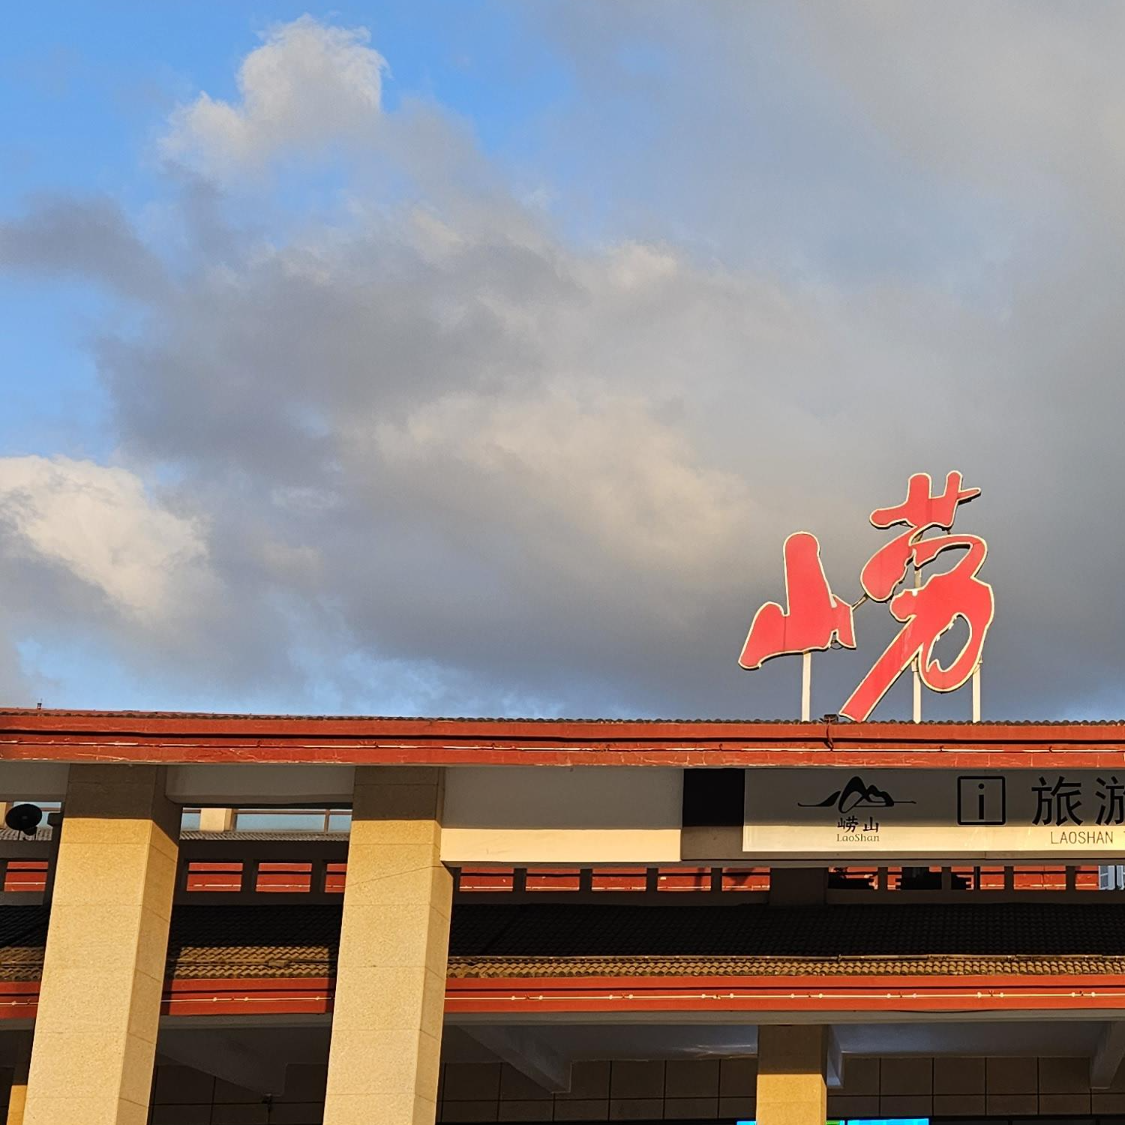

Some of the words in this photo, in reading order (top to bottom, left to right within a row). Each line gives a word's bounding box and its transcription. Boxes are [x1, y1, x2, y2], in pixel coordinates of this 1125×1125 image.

[837, 815, 880, 833] 崂山
[836, 833, 880, 842] LaoShan
[1049, 830, 1113, 845] LAOSHAN
